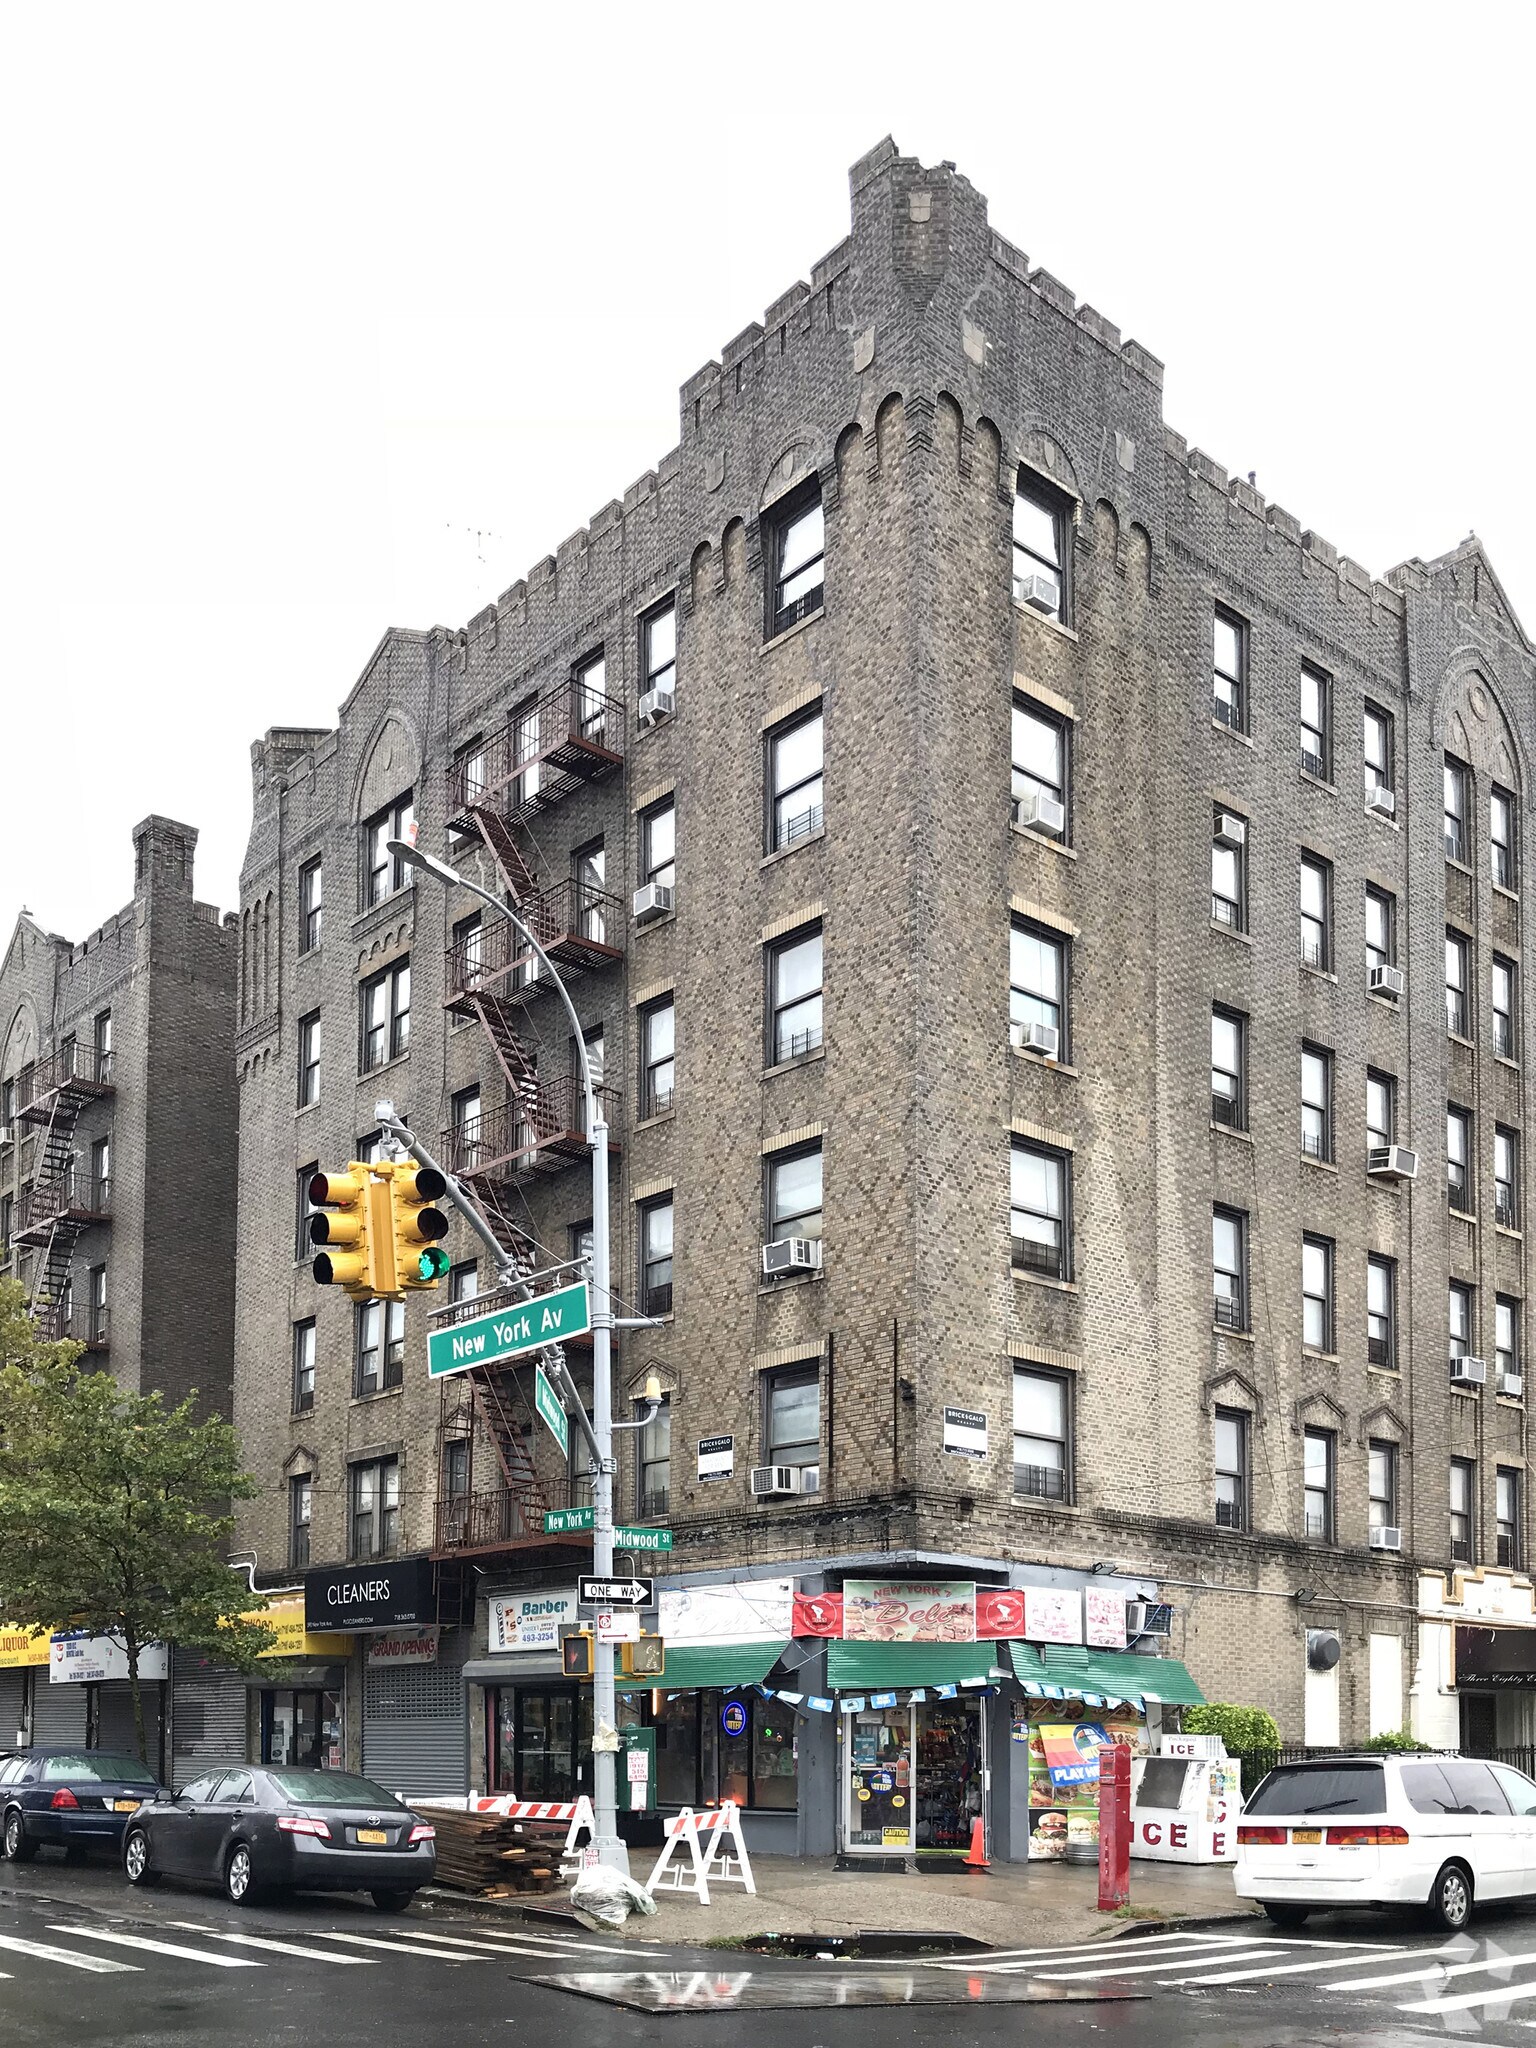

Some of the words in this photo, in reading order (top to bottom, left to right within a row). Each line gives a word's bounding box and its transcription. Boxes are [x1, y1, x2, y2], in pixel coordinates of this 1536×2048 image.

[452, 1334, 485, 1360] New
[493, 1316, 531, 1346] York
[541, 1307, 563, 1333] Av
[548, 1514, 564, 1530] New
[566, 1511, 583, 1529] York
[584, 1510, 592, 1520] Av
[615, 1529, 659, 1547] Midwood
[662, 1532, 670, 1544] St
[327, 1579, 390, 1606] CLEANERS
[590, 1585, 612, 1597] ONE
[620, 1586, 643, 1597] WAY
[873, 1586, 902, 1599] NEW
[906, 1584, 941, 1597] YORK
[522, 1600, 569, 1616] Barber
[872, 1600, 954, 1624] Deli
[0, 1635, 30, 1652] IQUOR
[522, 1632, 554, 1643] 493-3254
[373, 1640, 400, 1657] GRAND
[401, 1637, 435, 1655] OPENING
[161, 1662, 167, 1671] 2
[1492, 1673, 1524, 1685] Eighty
[1170, 1744, 1195, 1755] ICE
[1054, 1767, 1085, 1782] PLAY
[1085, 1765, 1100, 1779] HE
[884, 1828, 910, 1837] CAUTION
